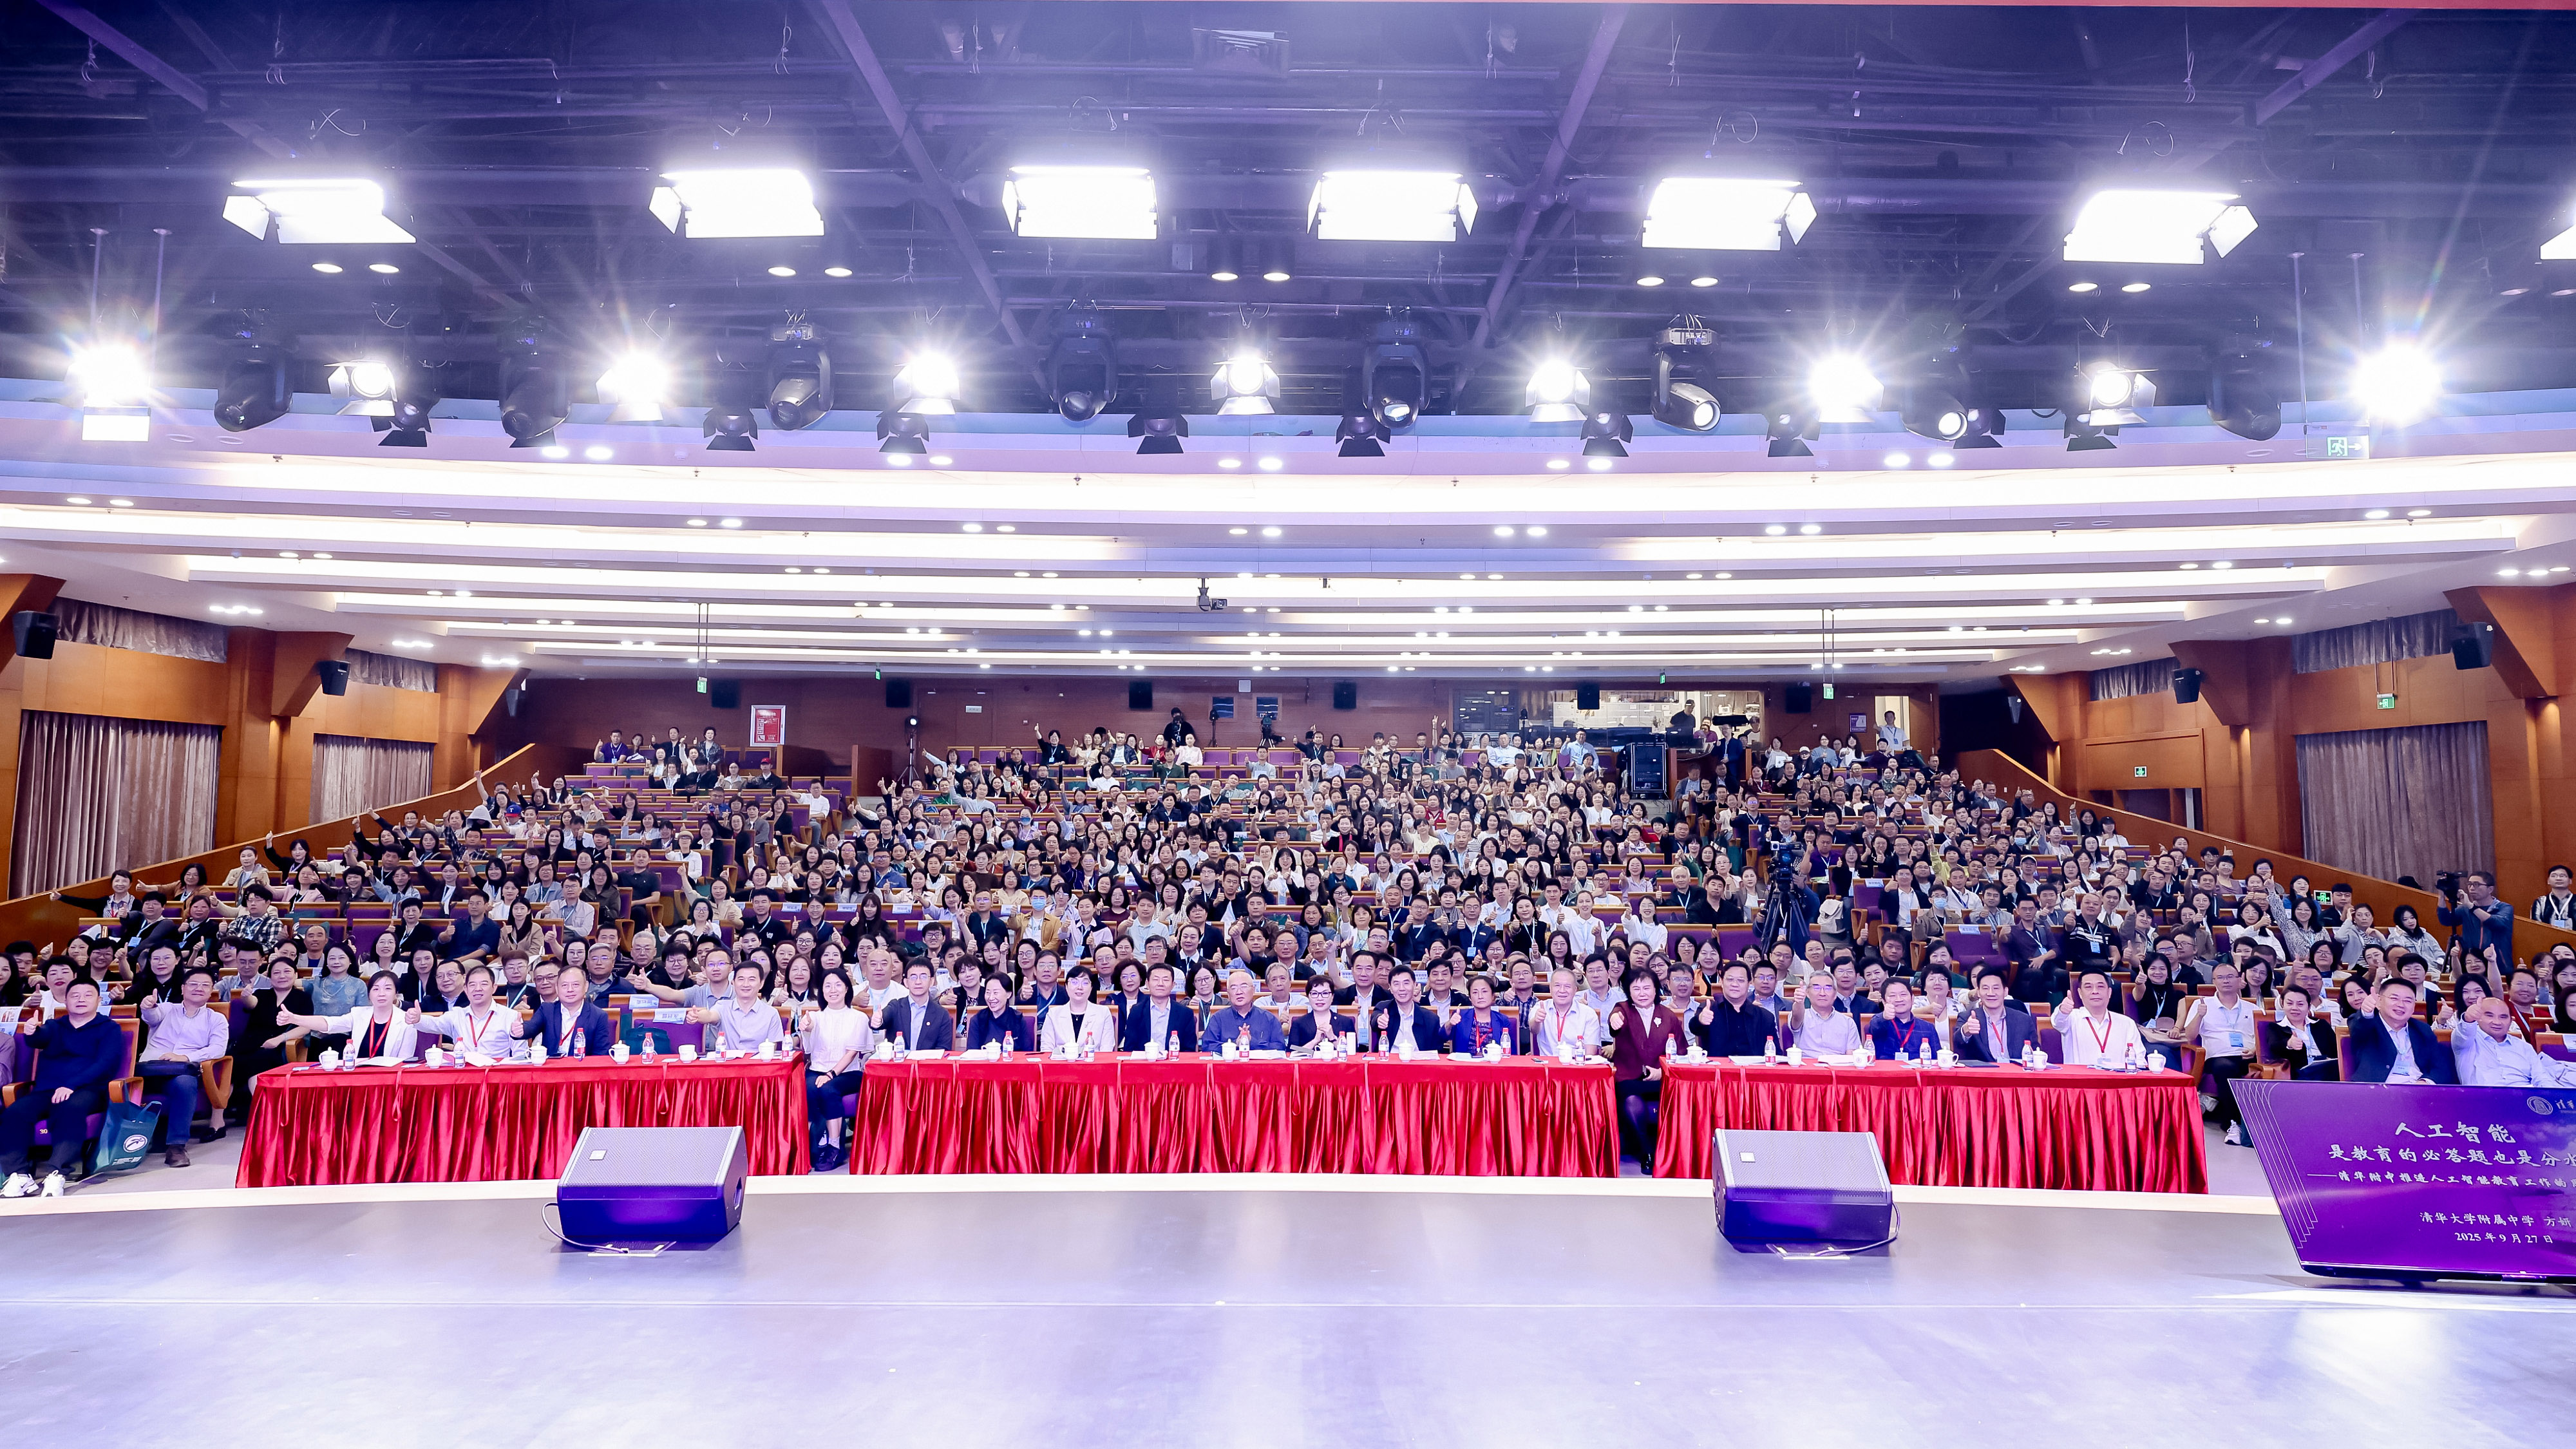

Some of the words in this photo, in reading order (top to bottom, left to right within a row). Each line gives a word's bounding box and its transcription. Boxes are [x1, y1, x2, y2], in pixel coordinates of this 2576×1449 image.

[2395, 1122, 2516, 1143] 人工智能
[2420, 1211, 2535, 1227] 清华大学附属中学
[2544, 1215, 2572, 1228] 方妍
[2454, 1231, 2553, 1244] 2025年9月27日
